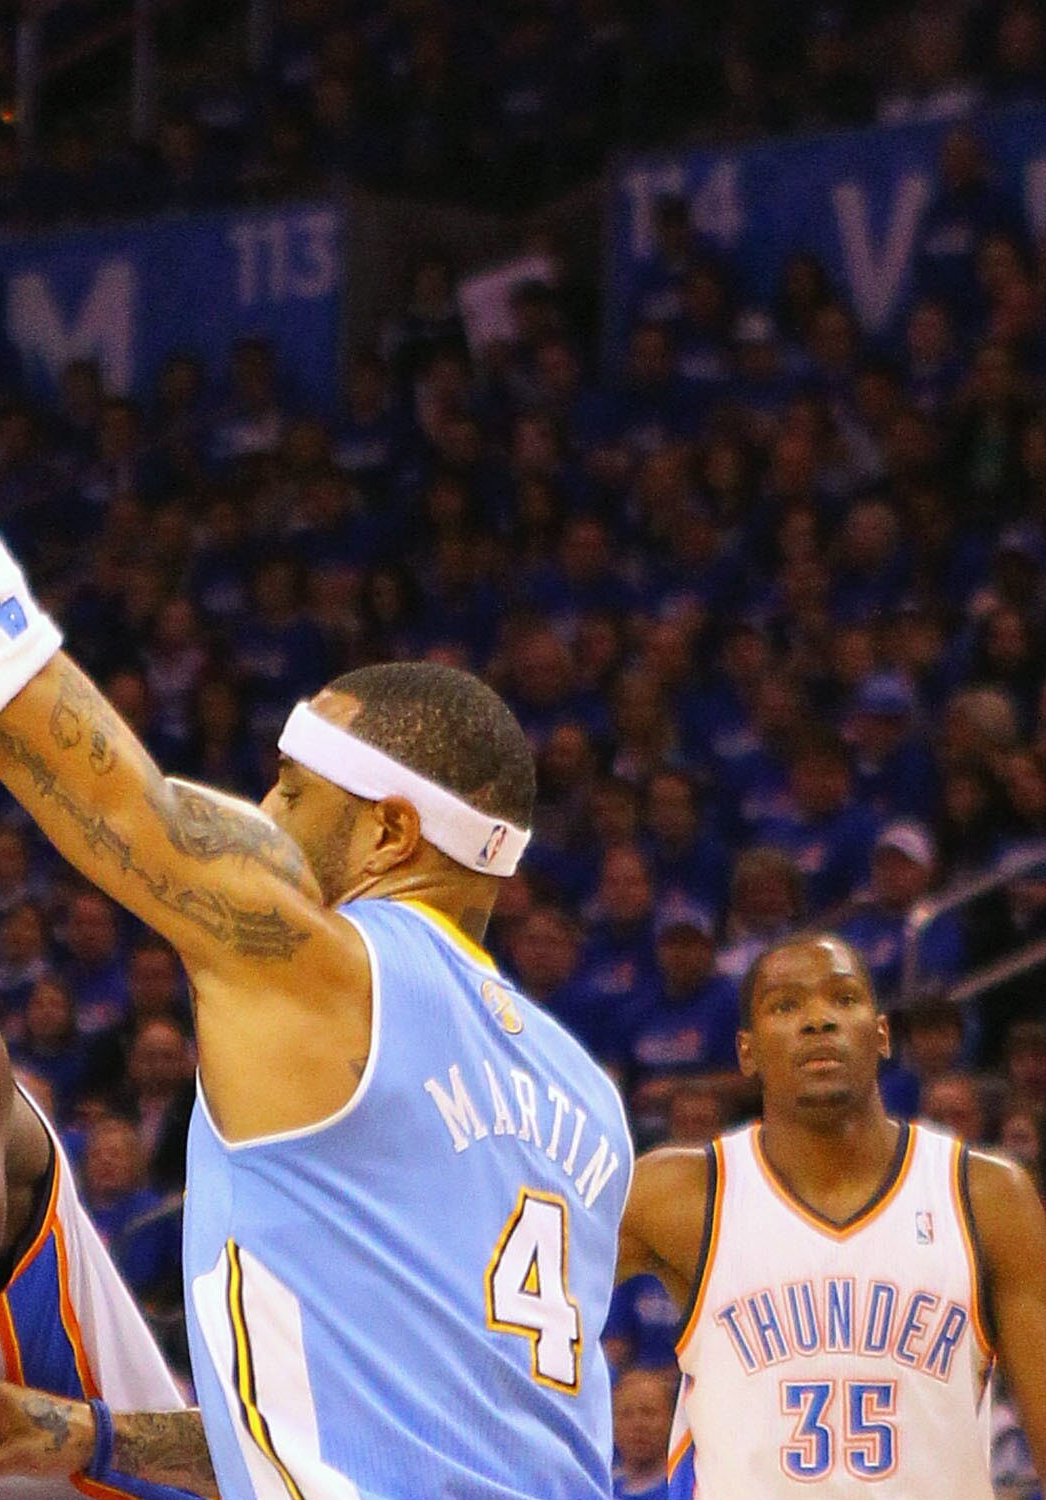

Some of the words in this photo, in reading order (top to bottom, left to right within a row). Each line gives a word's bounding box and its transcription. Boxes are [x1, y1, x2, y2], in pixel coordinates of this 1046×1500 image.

[228, 207, 340, 305] 113
[424, 1059, 619, 1209] MARTIN
[484, 1184, 583, 1396] 4
[714, 1277, 970, 1384] THUNDER
[779, 1379, 898, 1483] 35
